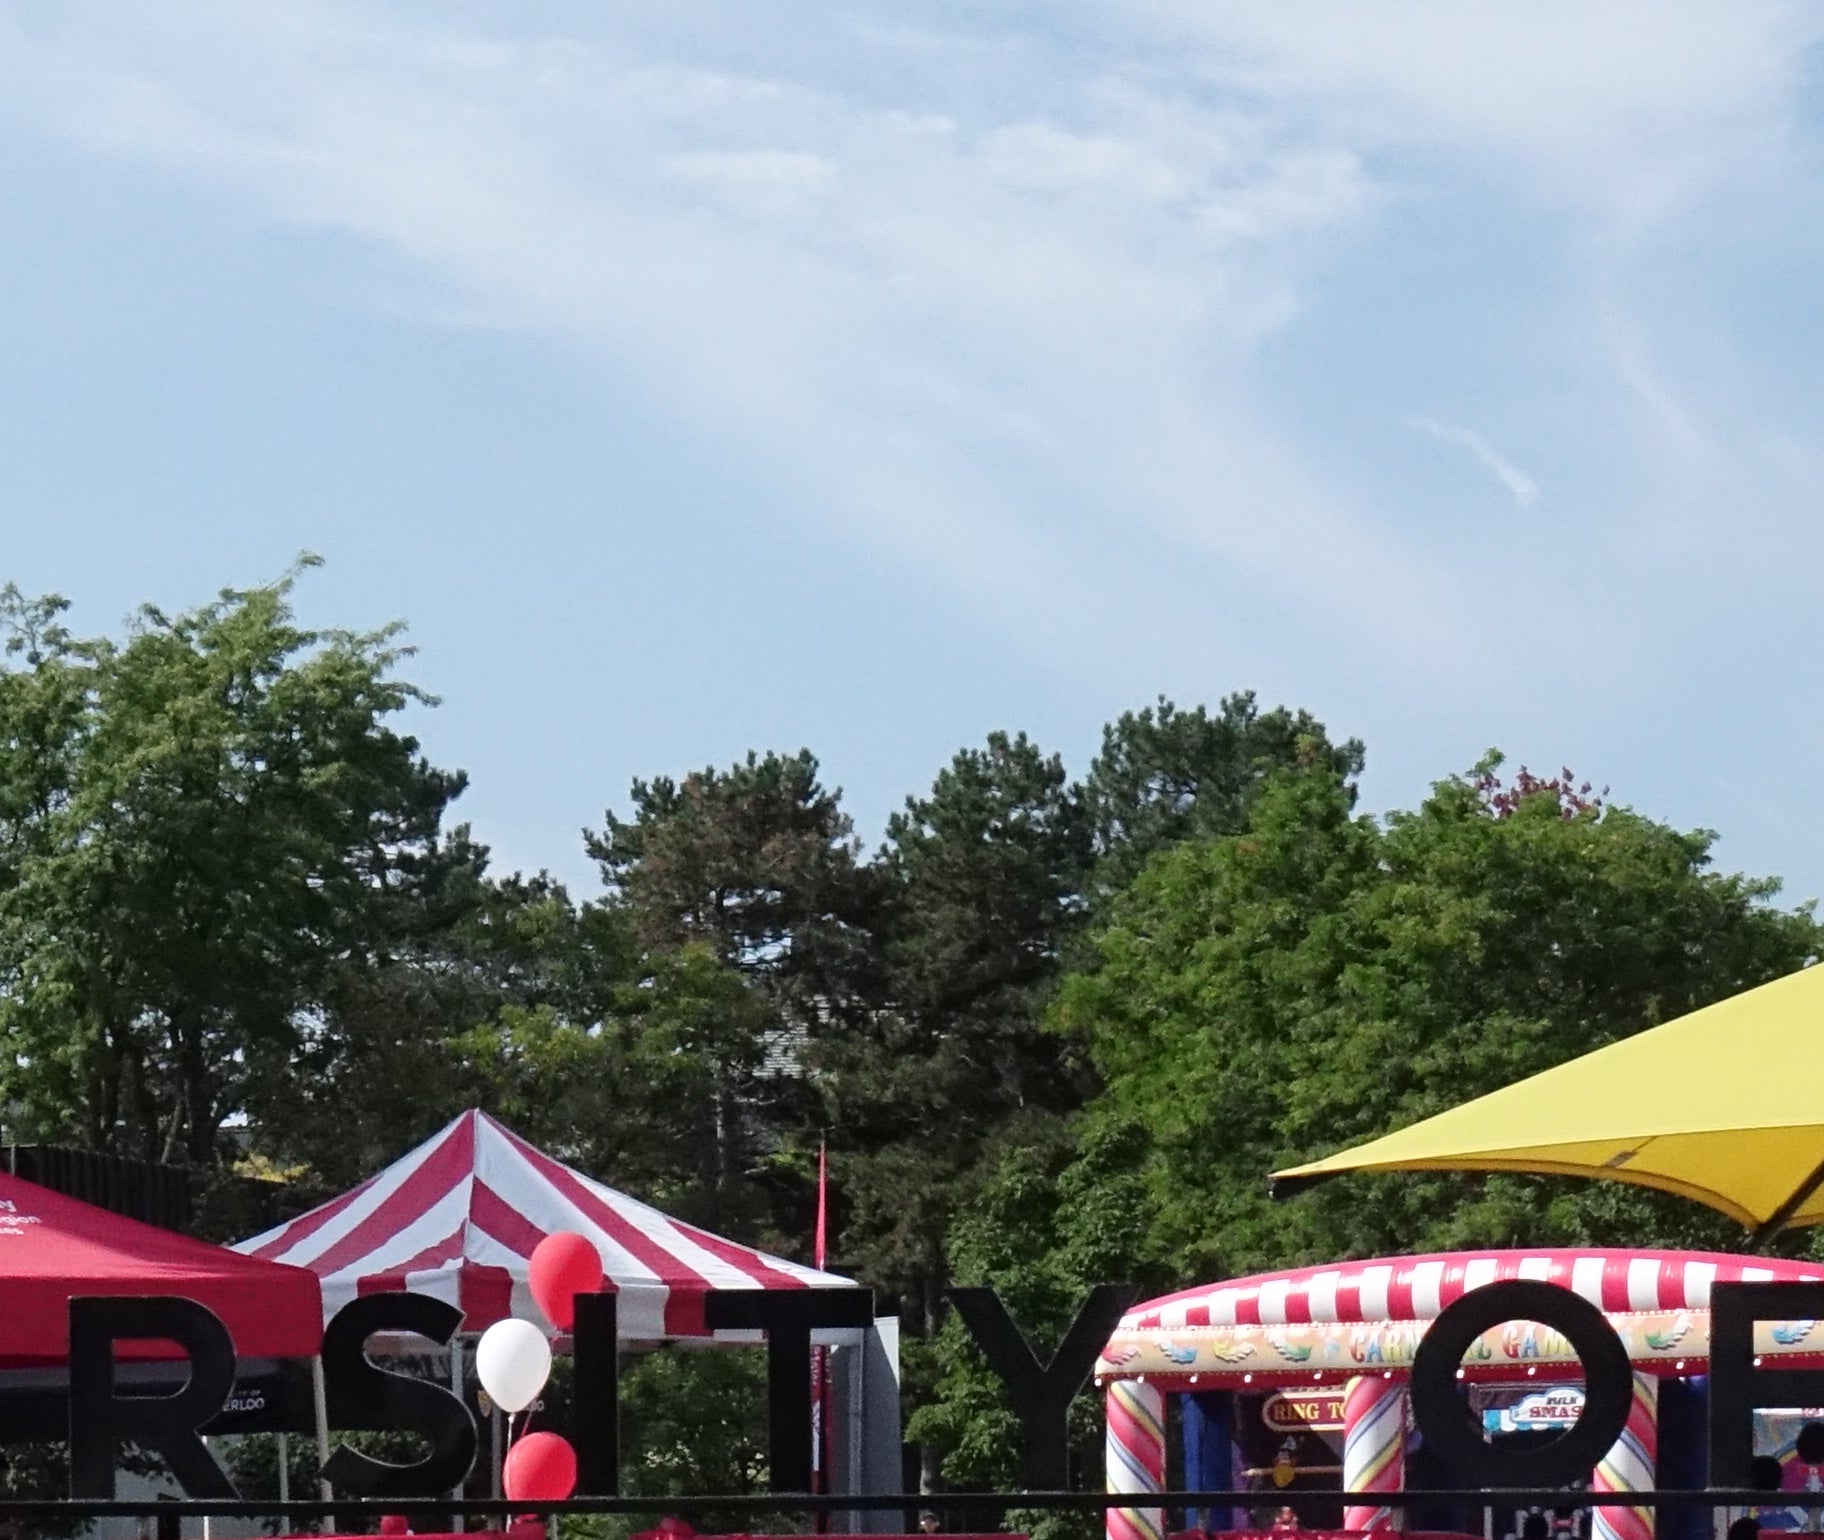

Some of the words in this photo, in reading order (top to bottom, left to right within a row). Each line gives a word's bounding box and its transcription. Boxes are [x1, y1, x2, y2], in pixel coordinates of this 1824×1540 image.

[222, 1397, 265, 1412] ERLOO
[1274, 1402, 1320, 1420] RING
[1529, 1405, 1582, 1418] SMAS
